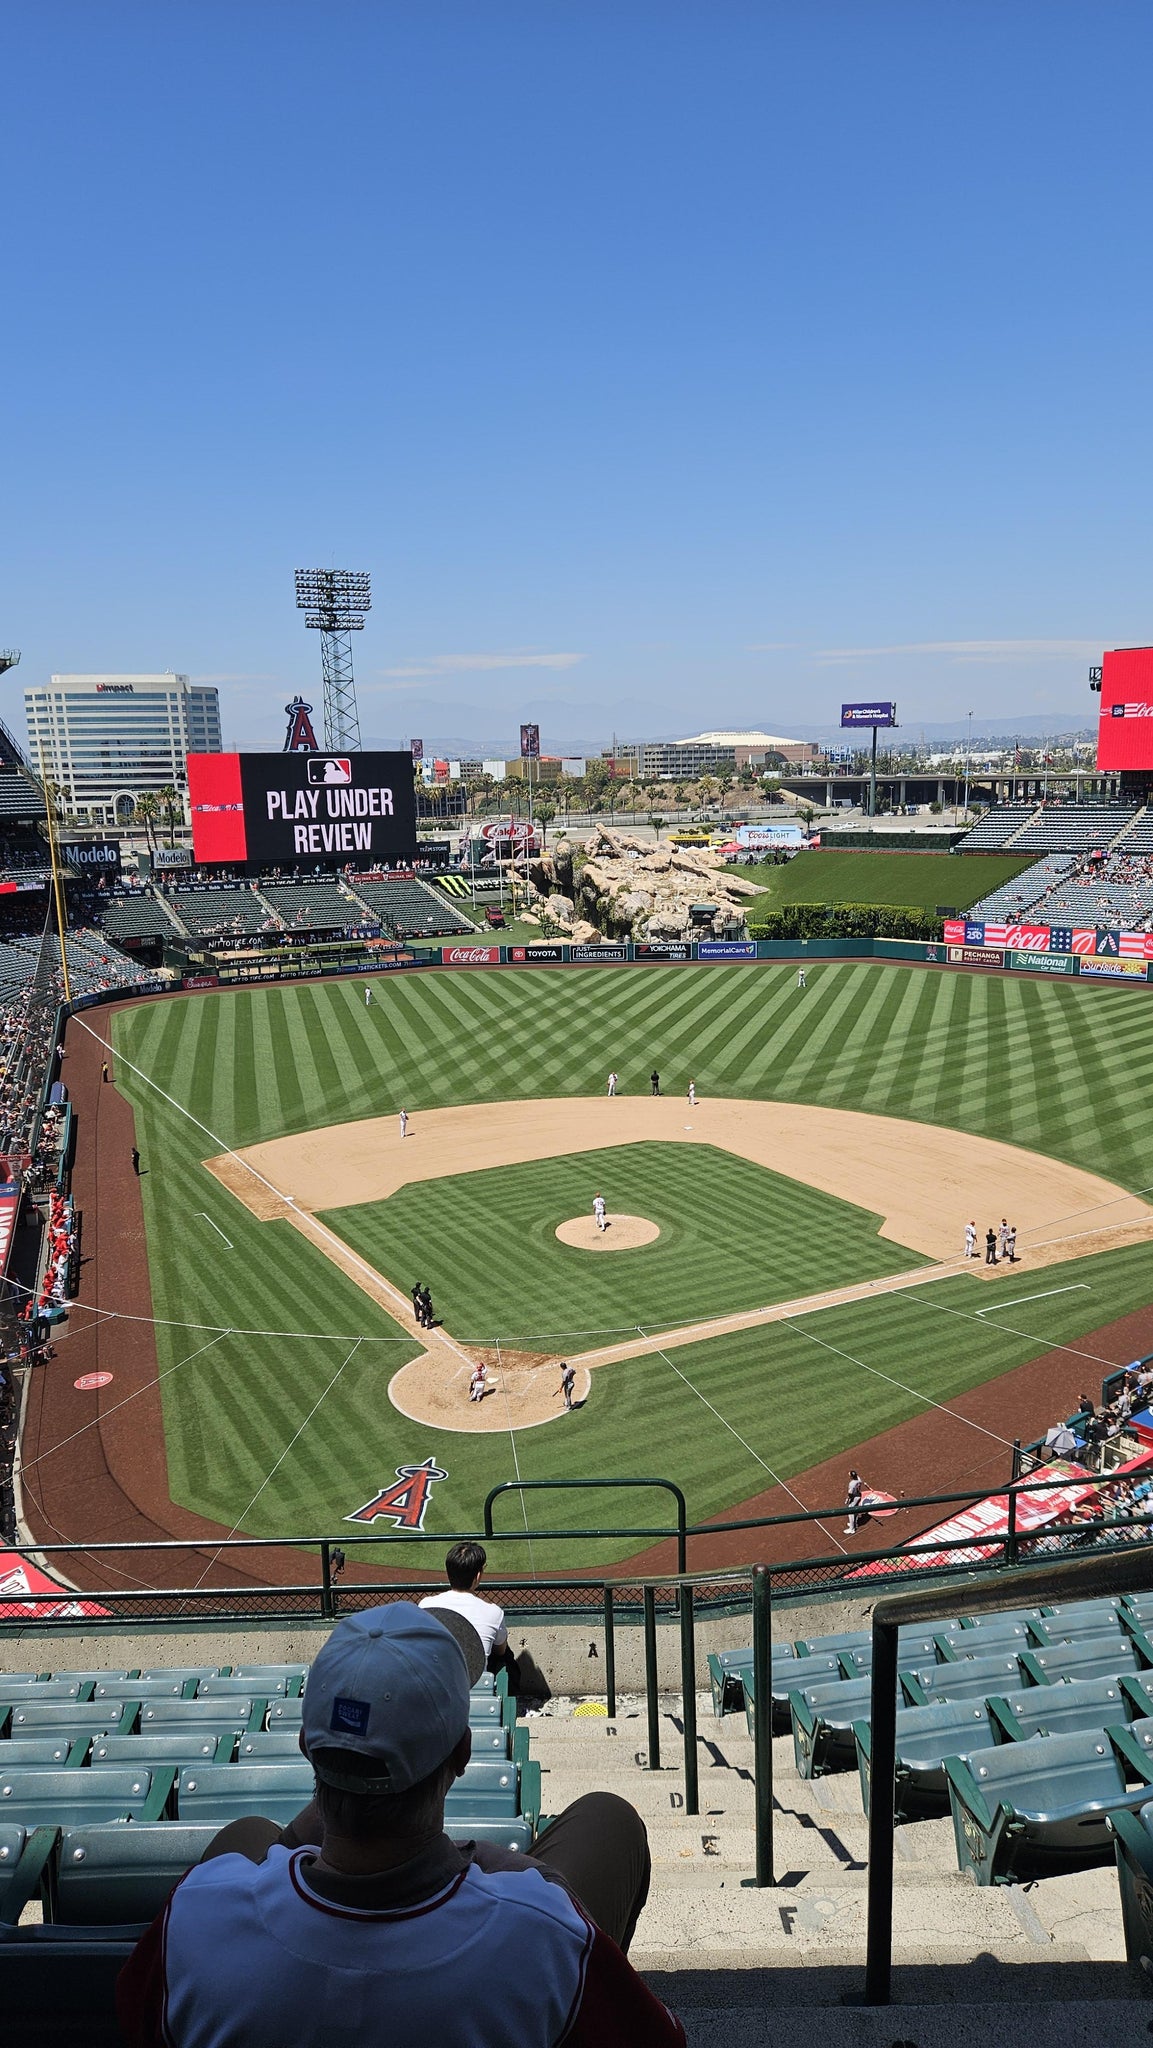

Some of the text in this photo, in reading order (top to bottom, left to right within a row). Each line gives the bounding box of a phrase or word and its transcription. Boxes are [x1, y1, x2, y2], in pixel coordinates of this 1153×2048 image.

[266, 788, 394, 820] PLAY UNDER
[294, 822, 372, 853] REVIEW
[748, 831, 769, 839] Coors
[65, 845, 117, 863] Modelo
[158, 850, 187, 864] Modelo
[450, 948, 490, 962] Coca-Cola
[650, 944, 686, 952] YOKOHAMA
[964, 951, 1000, 960] PECHANGA
[1028, 954, 1067, 967] National
[1083, 959, 1122, 973] Surfside
[140, 985, 162, 993] Modelo
[342, 1457, 448, 1531] A
[969, 1501, 1009, 1525] JUNE
[588, 1642, 599, 1658] A
[634, 1752, 648, 1766] C
[669, 1792, 684, 1808] D
[701, 1835, 721, 1856] E
[778, 1906, 798, 1935] F
